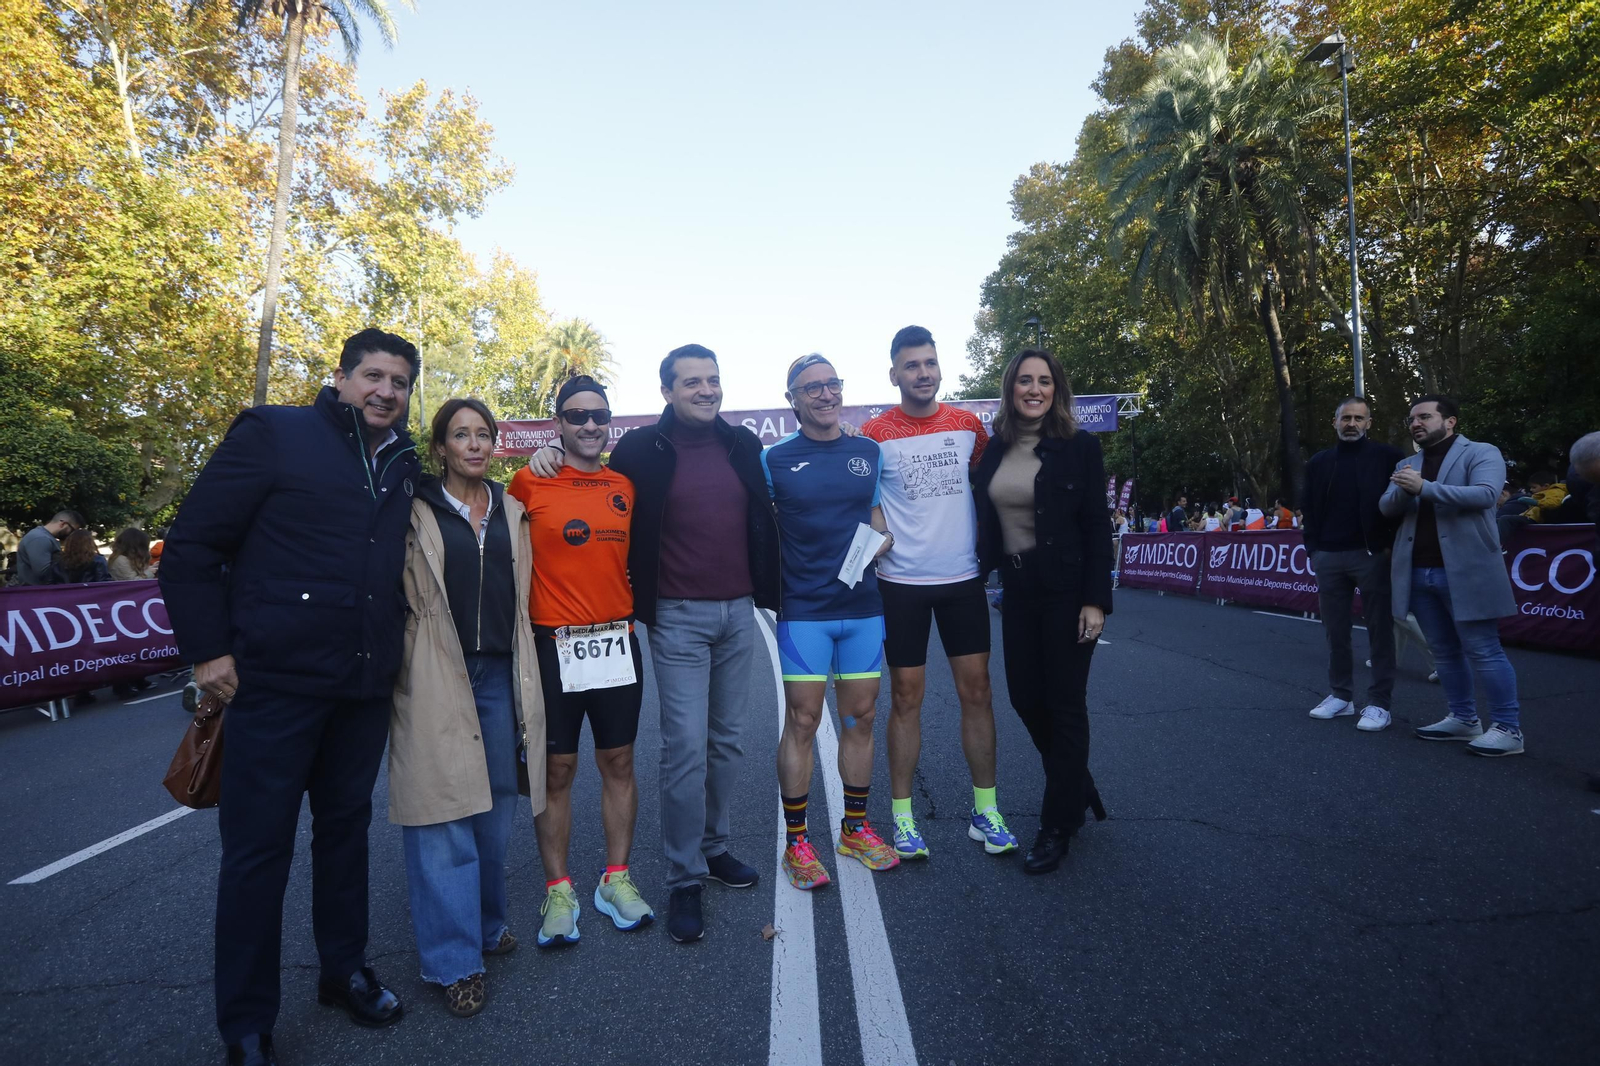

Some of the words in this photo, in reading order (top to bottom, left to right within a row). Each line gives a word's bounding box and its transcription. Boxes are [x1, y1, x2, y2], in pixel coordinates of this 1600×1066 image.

[1070, 404, 1111, 414] NTAMIENTO
[505, 429, 556, 440] AYUNTAMIENTO
[505, 440, 514, 449] DE
[911, 454, 922, 464] 11
[923, 451, 958, 461] CARRERA
[926, 458, 959, 468] URBANA
[941, 478, 962, 486] CIUDAD
[1139, 543, 1198, 569] IMDECO
[1226, 575, 1254, 586] Municipal
[1255, 578, 1262, 586] de
[1263, 578, 1292, 590] Deportes
[1293, 581, 1318, 593] Córdob
[1520, 602, 1585, 620] Córdoba
[0, 597, 175, 657] MDECO
[573, 636, 626, 660] 6671
[49, 662, 70, 677] de
[74, 652, 137, 673] Deportes
